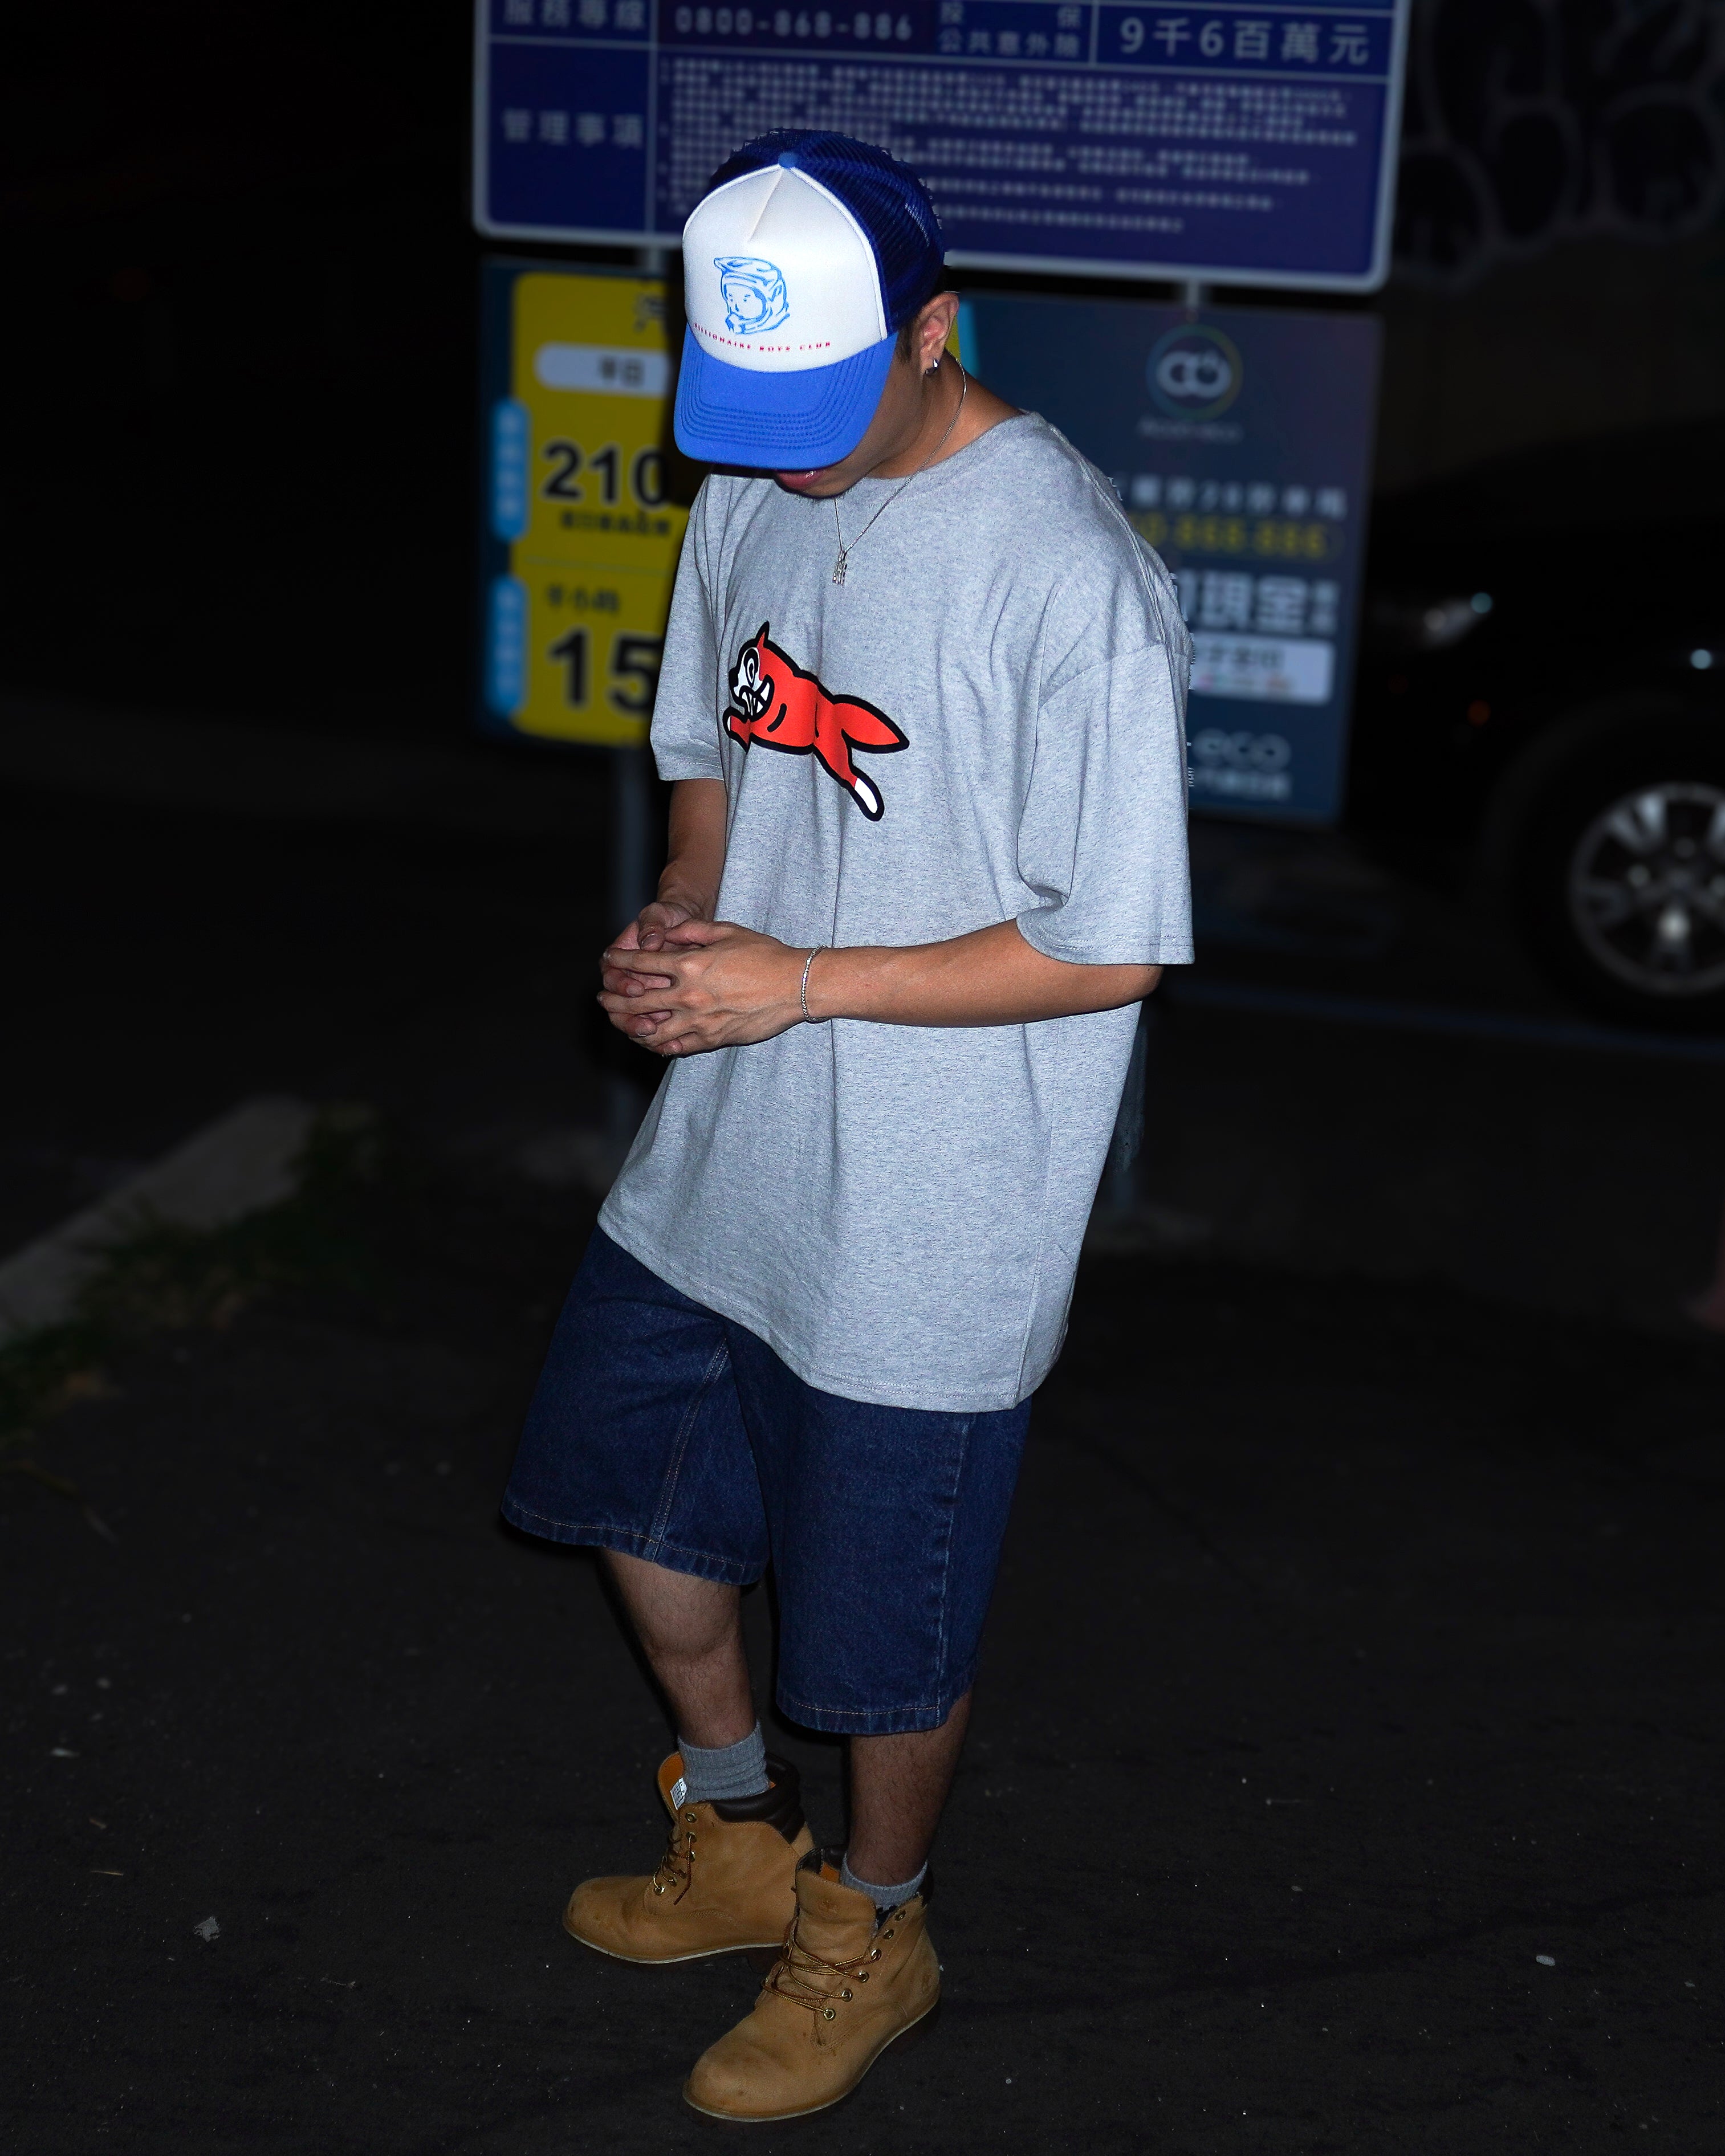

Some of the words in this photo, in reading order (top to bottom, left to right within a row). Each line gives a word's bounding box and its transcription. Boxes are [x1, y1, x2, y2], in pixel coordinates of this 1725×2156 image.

[675, 6, 912, 41] 0800-868-886
[1119, 16, 1369, 66] 9千6百萬元
[799, 341, 831, 351] CLUB
[545, 438, 670, 508] 210
[551, 630, 664, 714] 15
